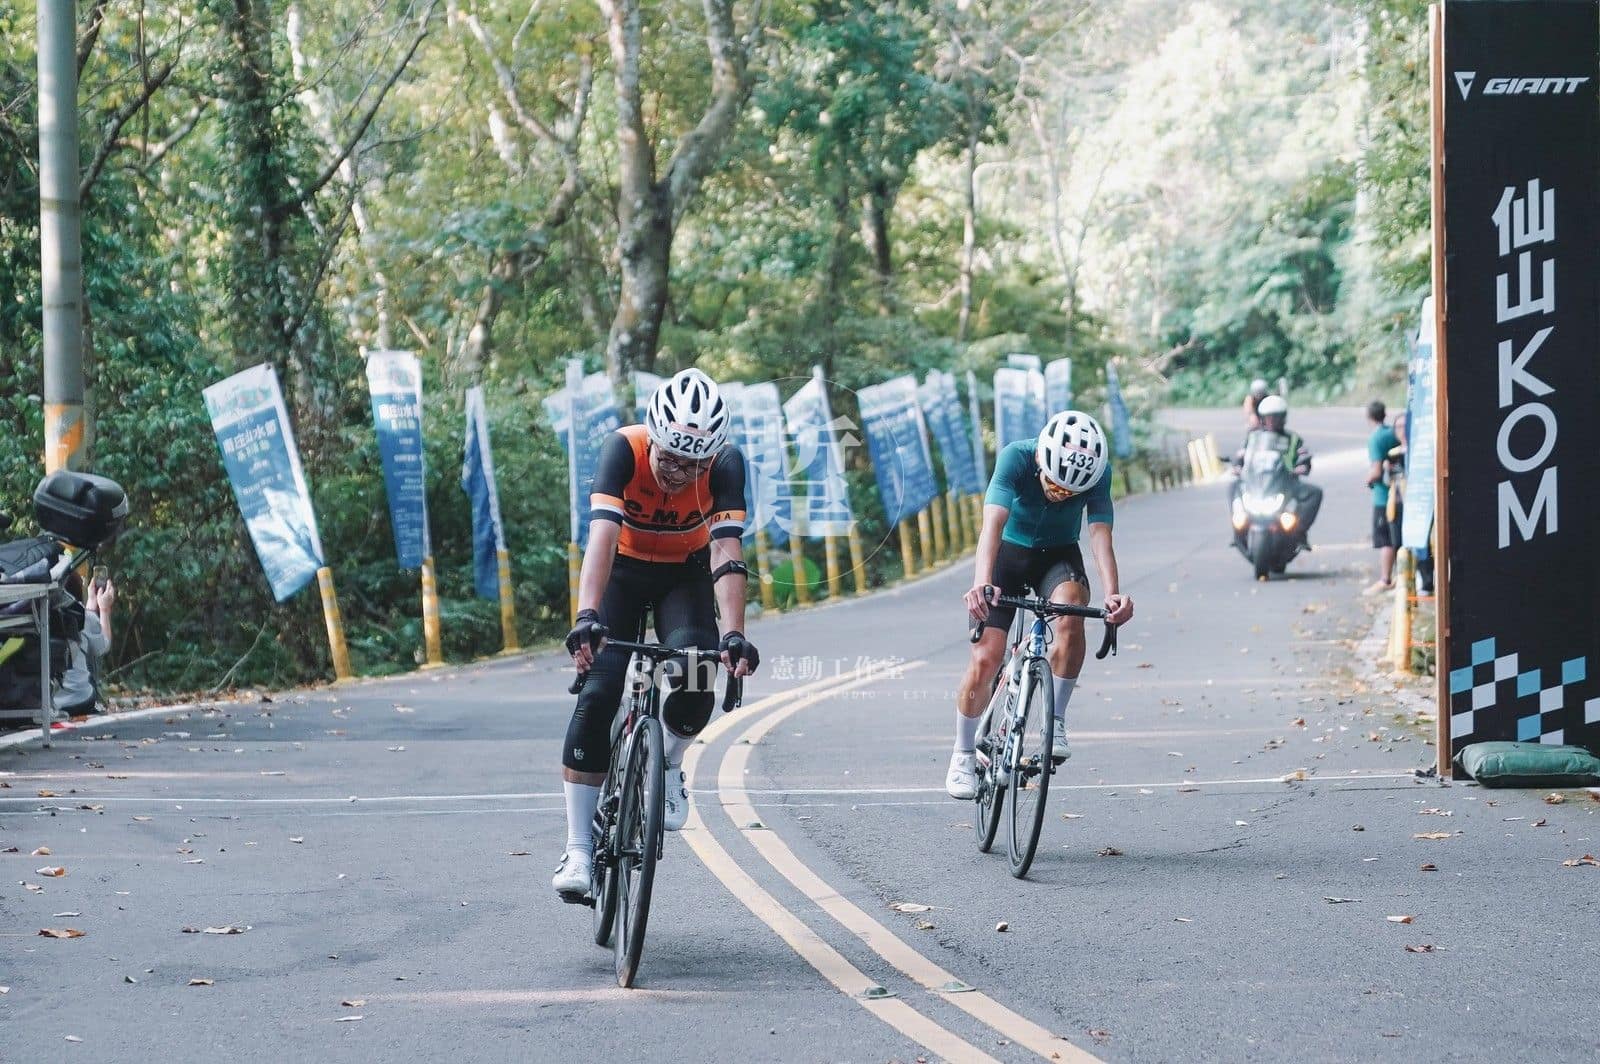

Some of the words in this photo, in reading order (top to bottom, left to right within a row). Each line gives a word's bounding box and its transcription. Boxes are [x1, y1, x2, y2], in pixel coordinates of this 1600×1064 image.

[1482, 77, 1590, 95] GIANT
[669, 431, 704, 454] 326
[1066, 451, 1095, 470] 432
